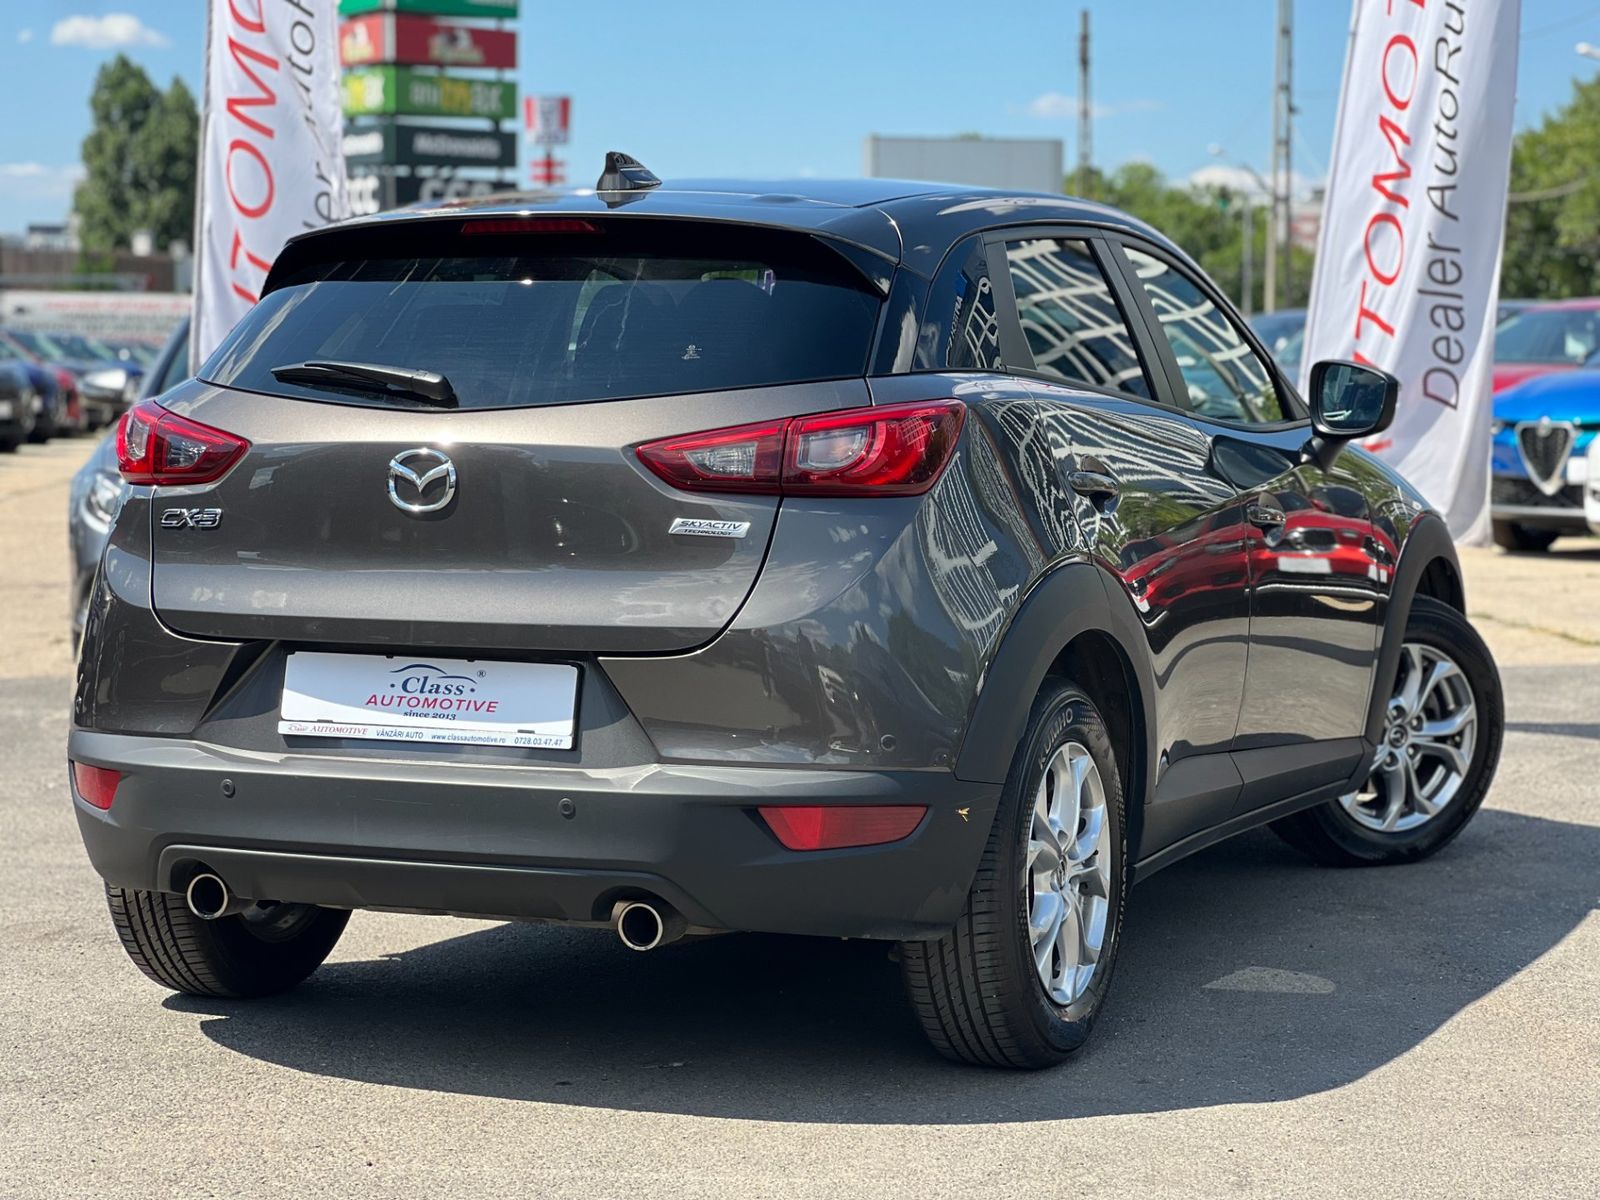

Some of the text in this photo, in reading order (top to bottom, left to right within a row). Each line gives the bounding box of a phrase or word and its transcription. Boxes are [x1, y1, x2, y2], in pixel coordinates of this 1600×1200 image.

[1417, 0, 1468, 411] Dealer AutoRu
[160, 507, 223, 528] CX-3
[678, 520, 744, 530] SKYACTIV
[683, 528, 734, 536] TECHNOLOGY
[401, 675, 465, 697] Class
[365, 693, 500, 713] AUTOMOTIVE
[403, 709, 457, 721] since 2013
[310, 725, 369, 736] AUTOMOTIVE
[405, 730, 424, 740] AUTO
[431, 733, 506, 744] www.classautomotive.ro
[513, 736, 564, 747] 0728.03.47.47
[1038, 707, 1074, 771] KUMHO
